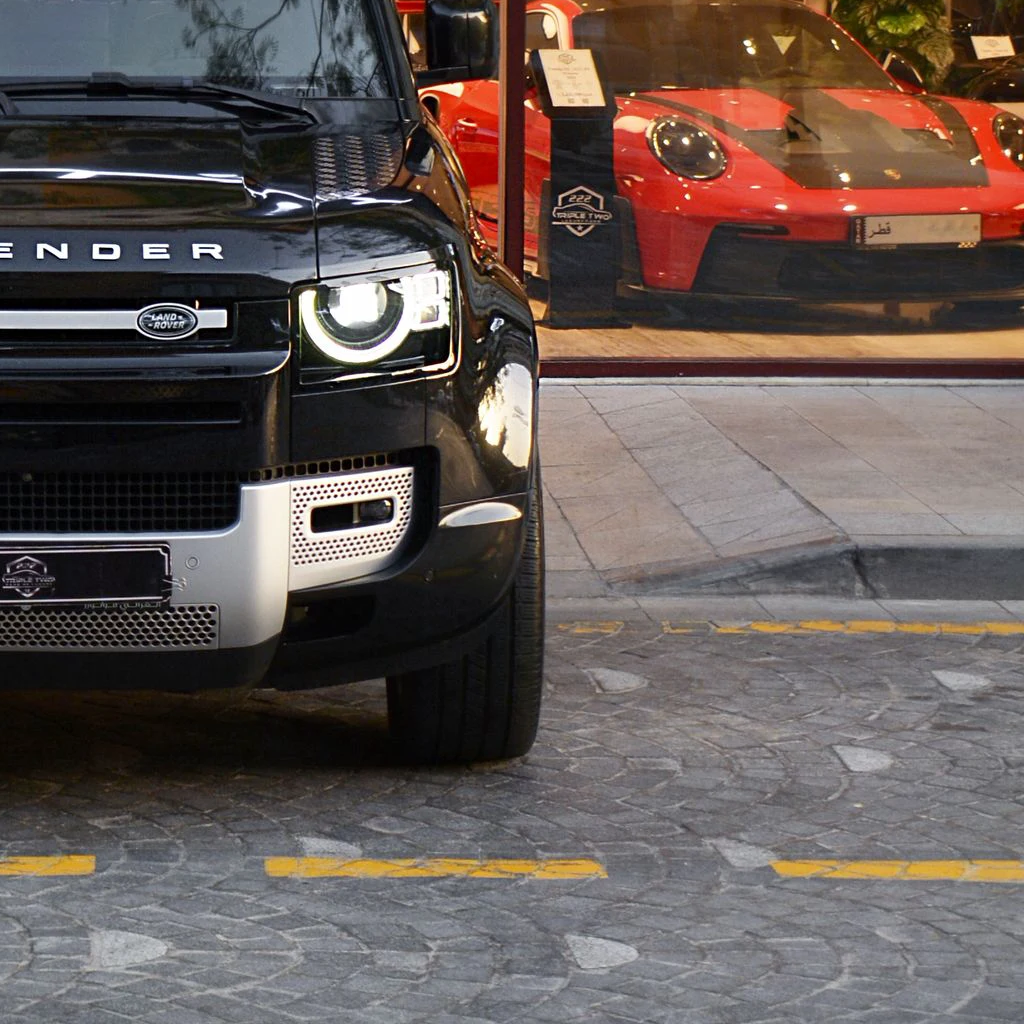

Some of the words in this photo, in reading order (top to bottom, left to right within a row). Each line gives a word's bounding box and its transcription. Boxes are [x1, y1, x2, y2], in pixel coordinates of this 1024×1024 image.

[568, 194, 592, 203] 222
[868, 221, 892, 239] قطر
[151, 313, 177, 321] LAND
[153, 321, 185, 329] ROVER
